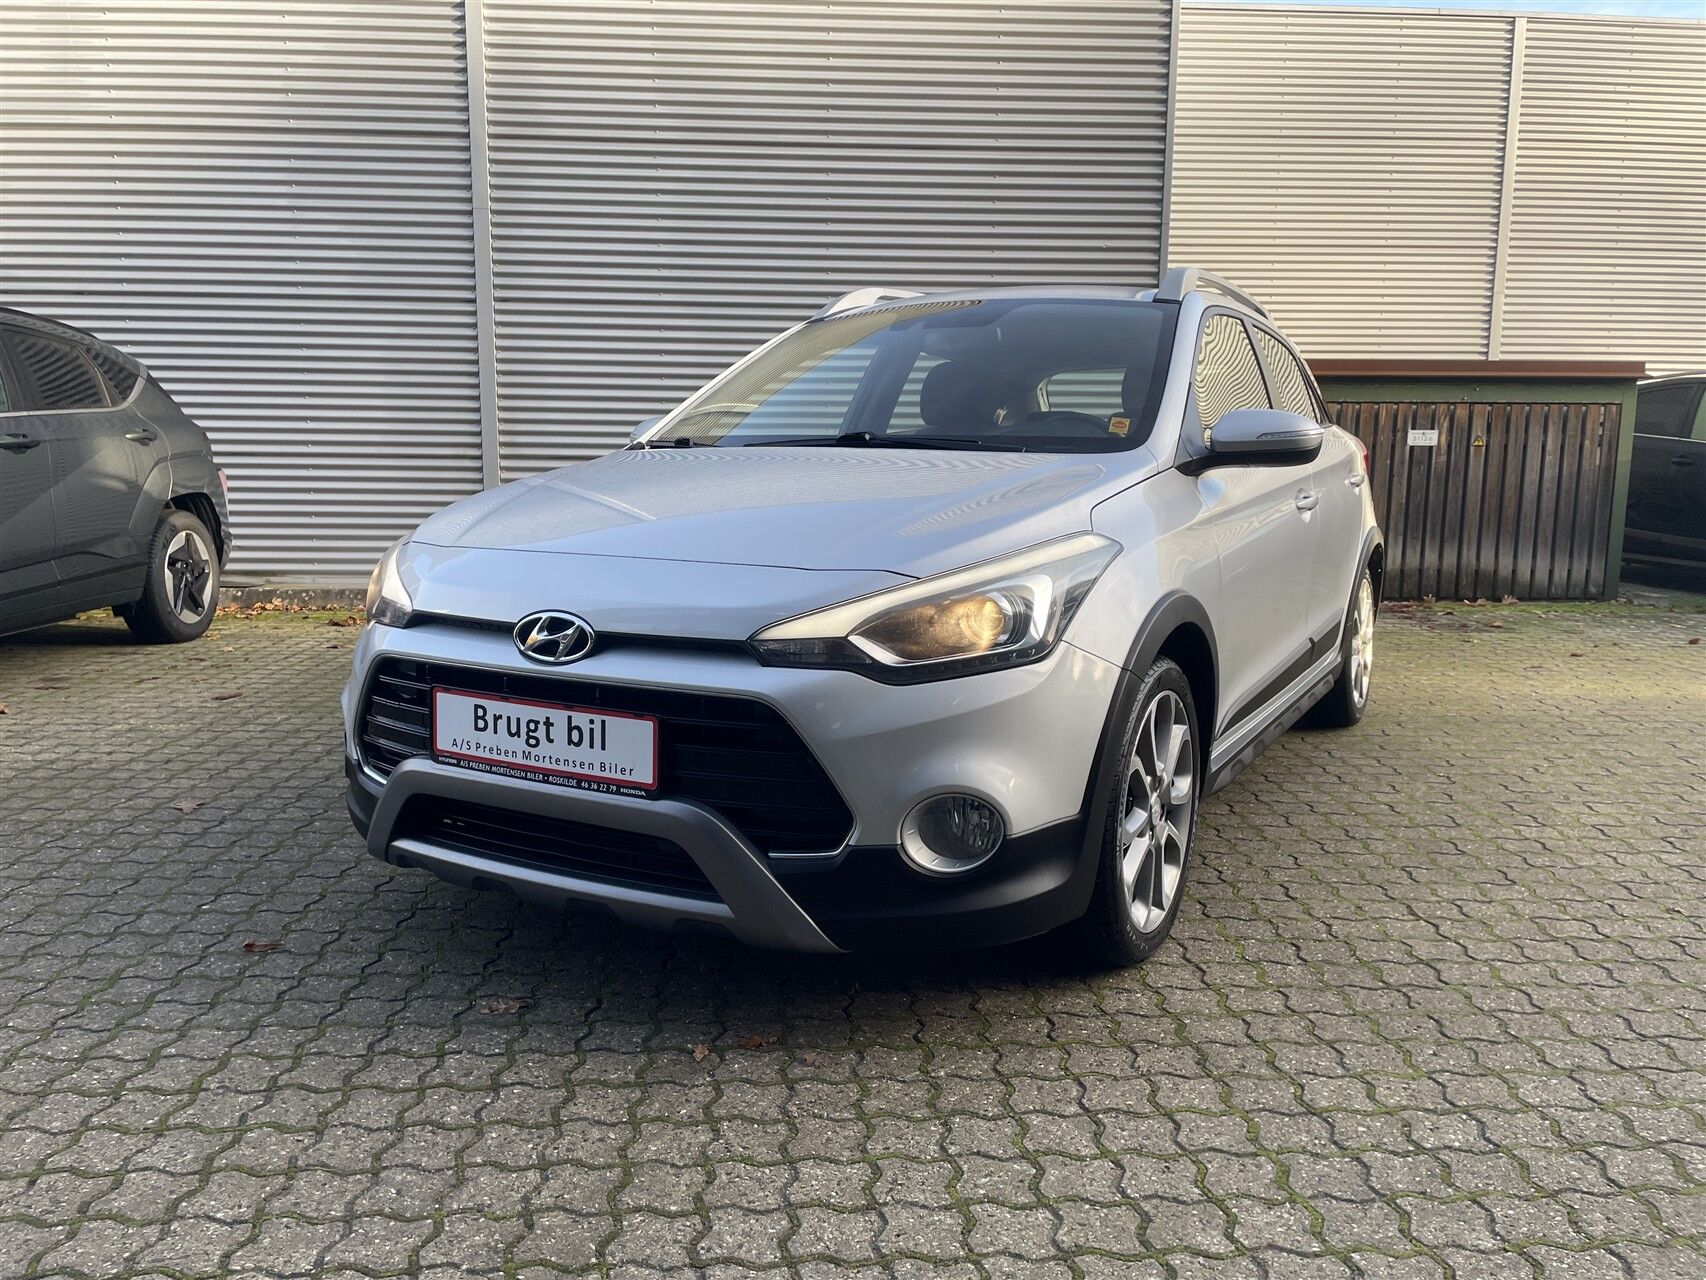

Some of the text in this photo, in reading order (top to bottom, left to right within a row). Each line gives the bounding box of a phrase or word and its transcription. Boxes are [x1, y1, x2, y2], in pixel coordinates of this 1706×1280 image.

[473, 703, 606, 751] Brugt bil
[451, 738, 634, 777] A/S Preben Mortensen Biler
[460, 760, 469, 768] A/S
[469, 762, 491, 772] PREBEN
[491, 766, 526, 777] MORTENSEN
[526, 772, 543, 782] BILER
[548, 775, 577, 787] ROSKILDE
[581, 781, 589, 789] 46
[590, 783, 598, 791] 36
[608, 785, 617, 793] 79
[620, 787, 646, 796] HONDA
